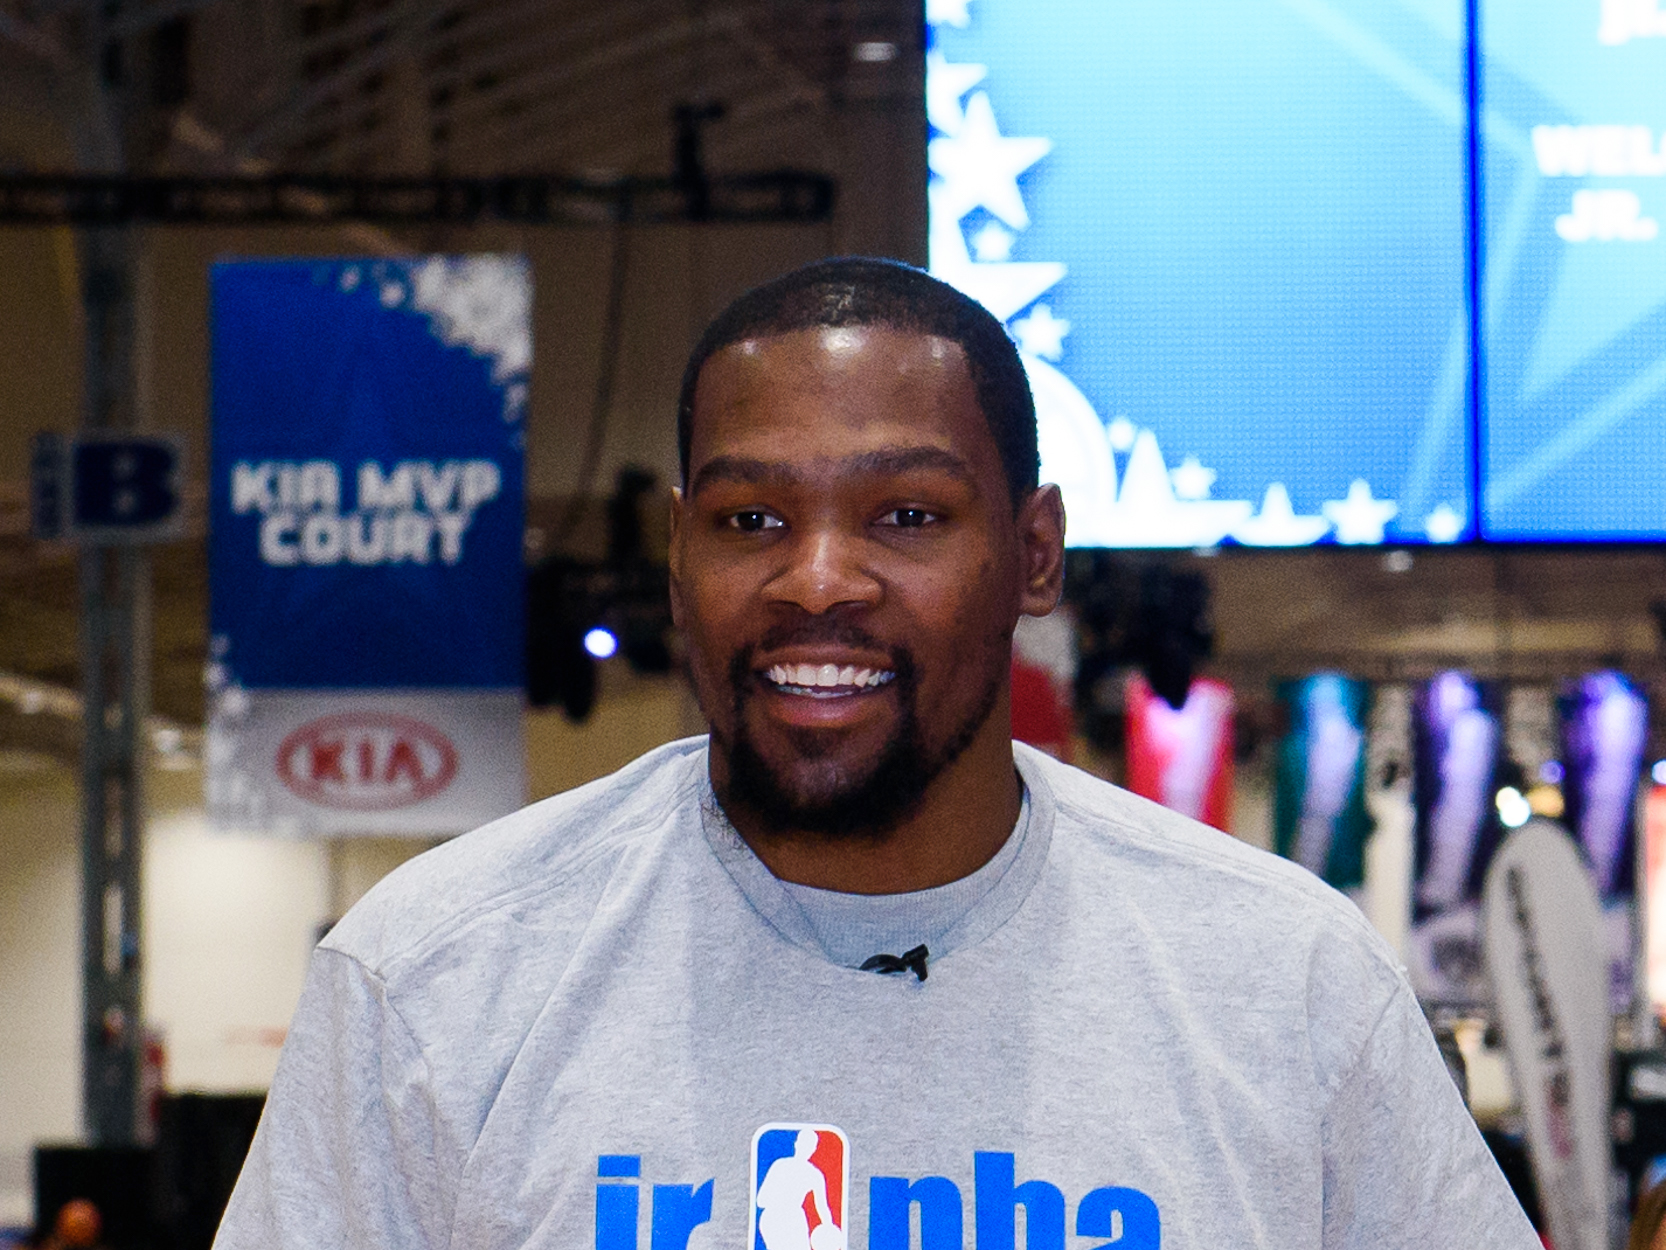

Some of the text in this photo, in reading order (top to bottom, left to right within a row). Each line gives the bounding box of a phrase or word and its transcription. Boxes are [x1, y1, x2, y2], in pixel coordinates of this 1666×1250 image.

[1532, 125, 1666, 176] WEL
[74, 441, 177, 525] B
[230, 462, 500, 514] KIA MVP
[259, 514, 468, 565] COURT
[310, 734, 426, 786] KIA
